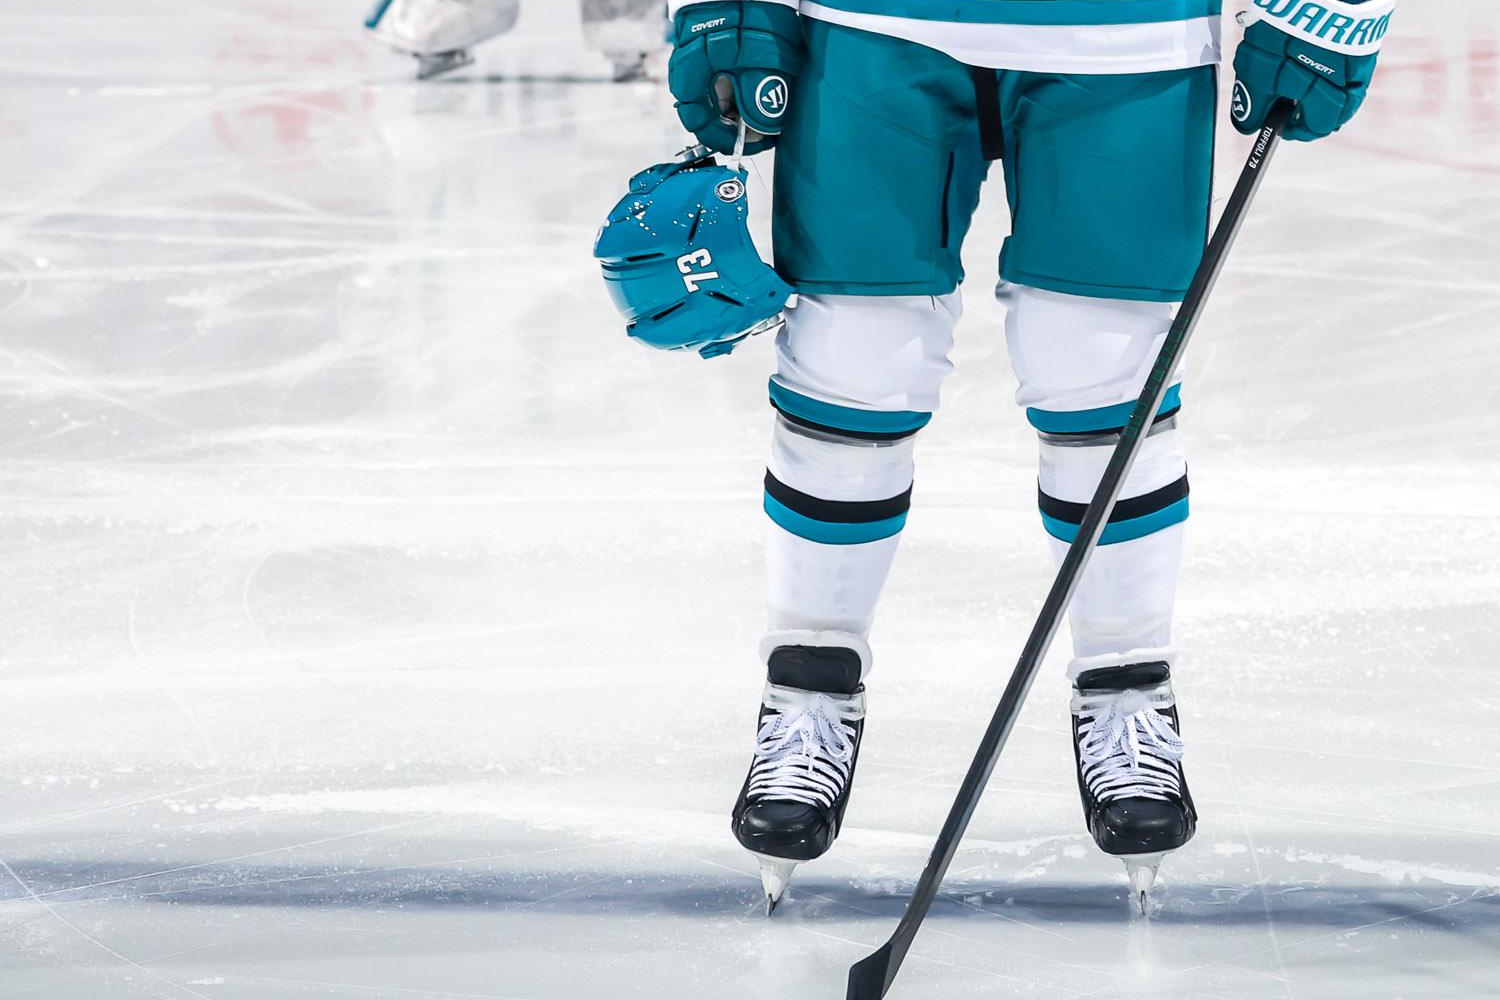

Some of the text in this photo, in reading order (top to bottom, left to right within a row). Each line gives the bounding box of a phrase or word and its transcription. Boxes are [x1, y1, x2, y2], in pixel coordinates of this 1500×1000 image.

[691, 17, 726, 33] COVERT
[1297, 53, 1336, 76] COVERT
[1254, 126, 1274, 158] TOFFOLI
[676, 247, 720, 294] 73
